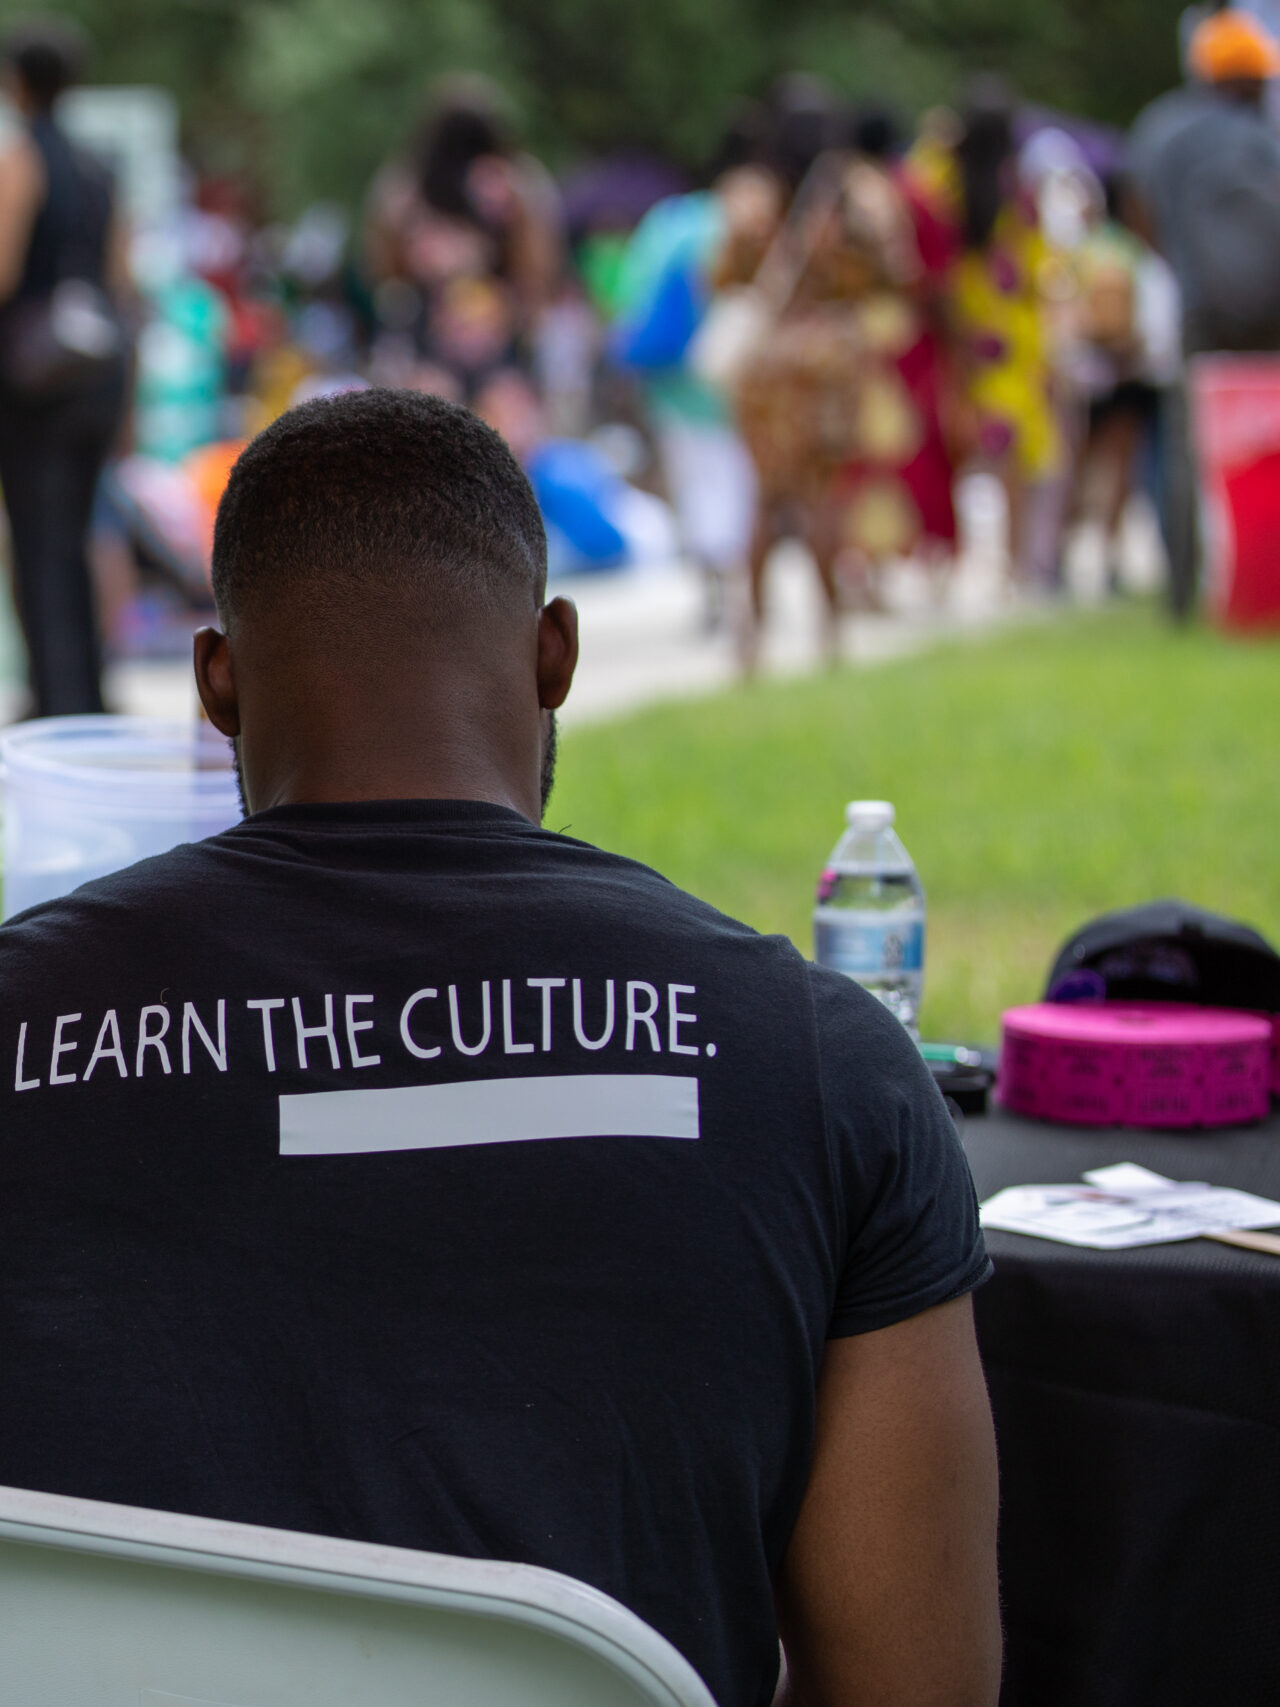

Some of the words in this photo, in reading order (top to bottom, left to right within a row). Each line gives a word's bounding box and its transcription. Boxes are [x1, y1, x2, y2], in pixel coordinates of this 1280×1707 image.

[14, 999, 228, 1092] LEARN
[246, 986, 381, 1072] THE
[399, 976, 717, 1059] CULTURE.
